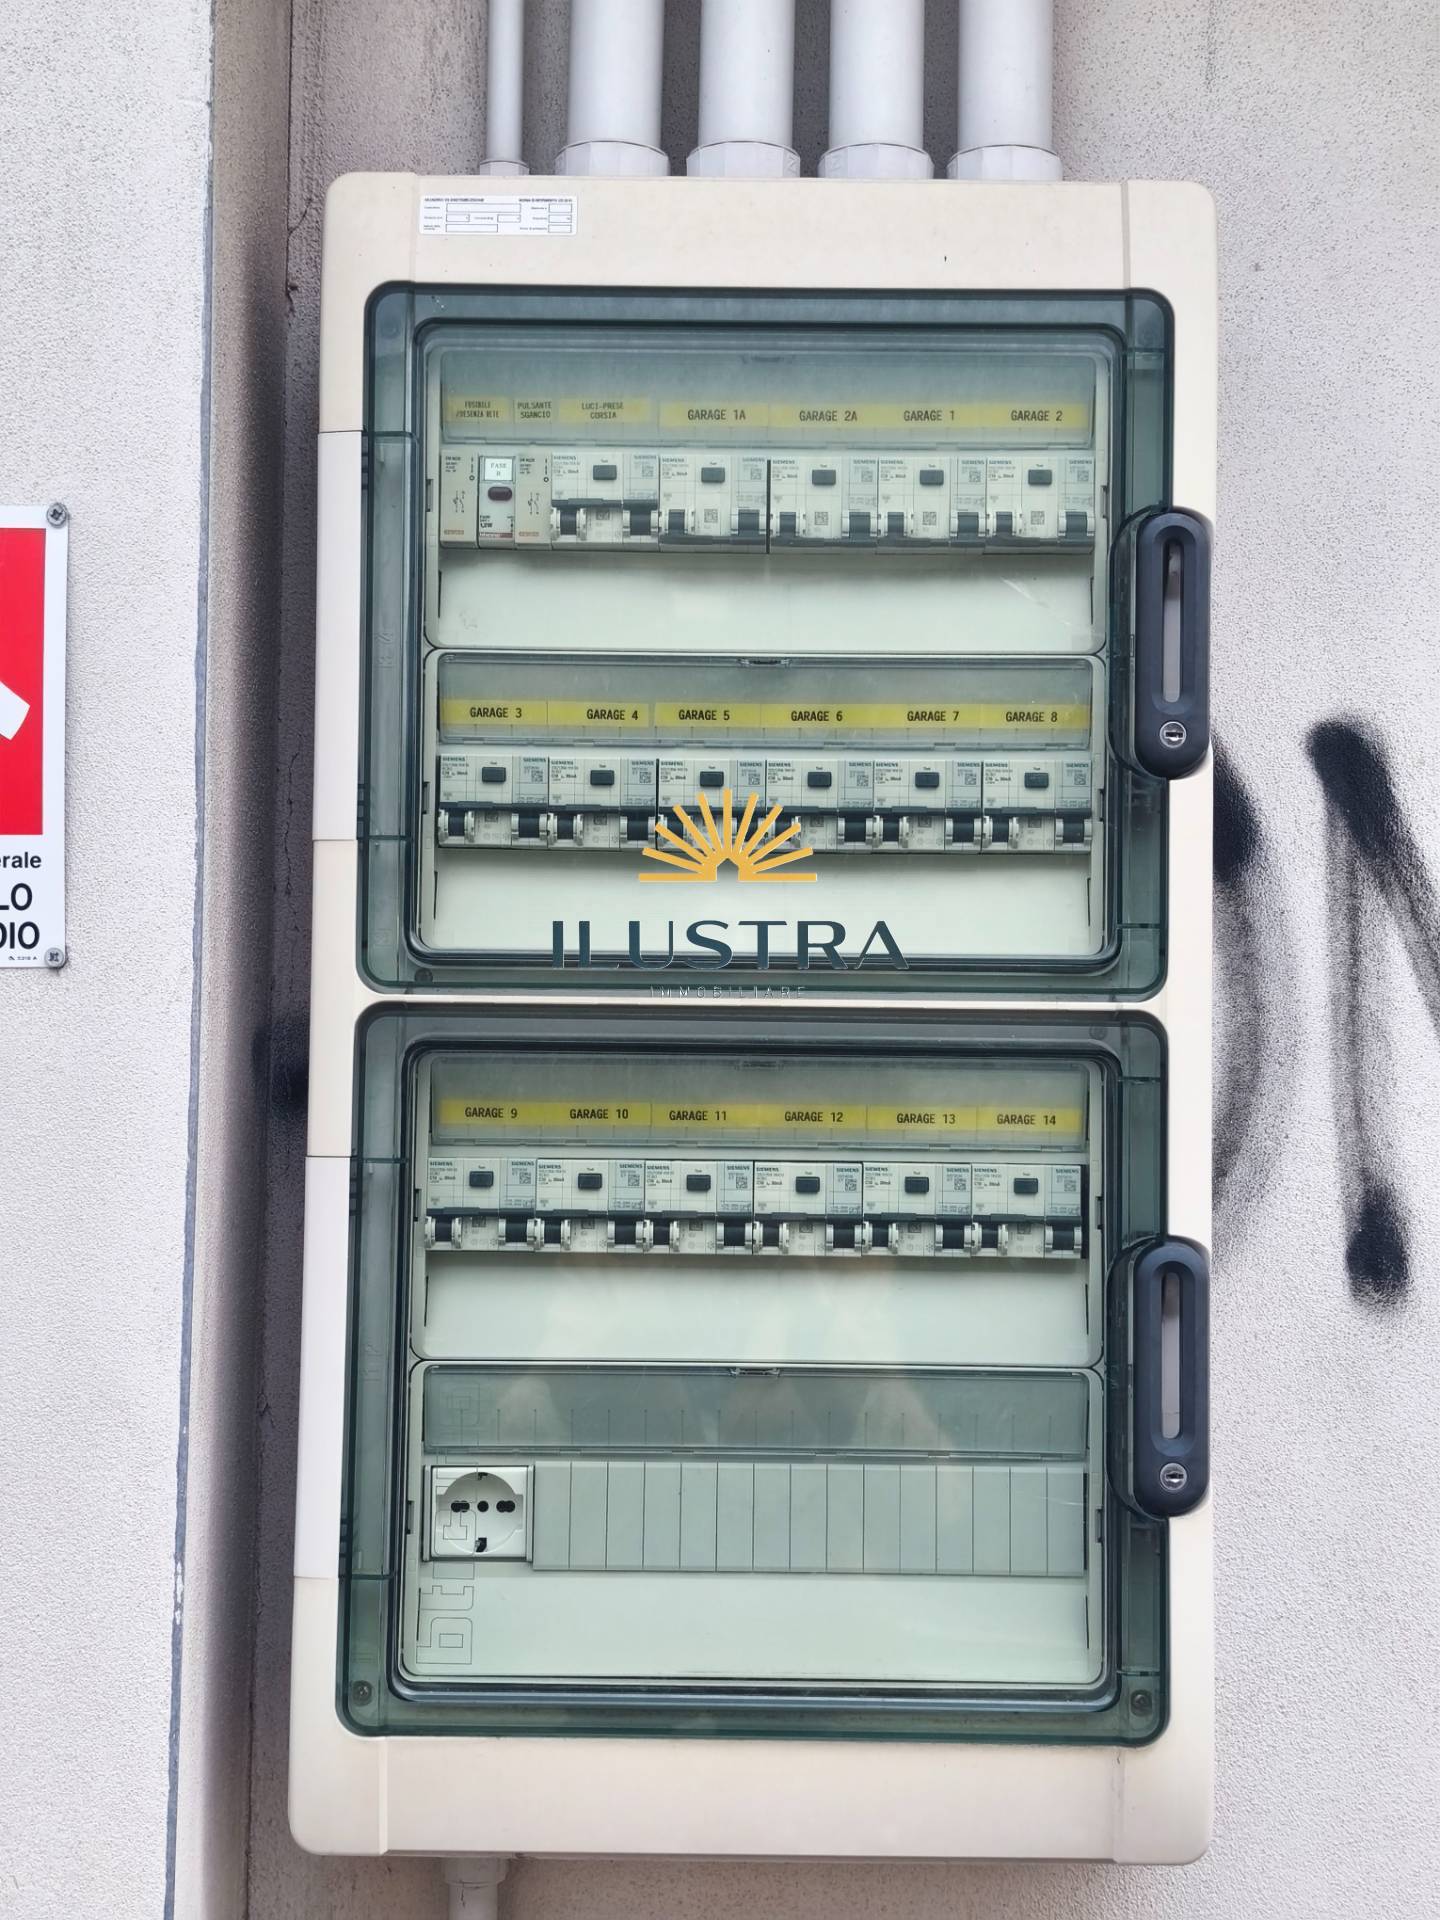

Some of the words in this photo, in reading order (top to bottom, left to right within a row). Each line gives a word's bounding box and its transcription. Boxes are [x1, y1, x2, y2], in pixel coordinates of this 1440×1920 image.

[517, 401, 552, 410] PULSANTE
[581, 401, 624, 410] LUCI-PRESE
[520, 411, 551, 419] SGANCIO
[590, 411, 617, 420] CORSIA
[687, 408, 727, 421] GARAGE
[734, 409, 747, 421] 1A
[799, 410, 838, 422] GARAGE
[844, 410, 858, 422] 2A
[903, 410, 943, 422] GARAGE
[949, 410, 955, 422] 1
[1010, 410, 1050, 422] GARAGE
[1056, 410, 1064, 422] 2
[469, 707, 509, 718] GARAGE
[515, 707, 523, 719] 3
[586, 709, 626, 721] GARAGE
[632, 709, 639, 721] 4
[678, 709, 718, 721] GARAGE
[723, 709, 731, 721] 5
[791, 710, 830, 722] GARAGE
[836, 710, 844, 722] 6
[907, 711, 947, 722] GARAGE
[953, 711, 960, 722] 7
[1005, 711, 1045, 723] GARAGE
[1051, 711, 1058, 723] 8
[0, 851, 42, 868] rale
[464, 1107, 504, 1119] GARAGE
[510, 1107, 519, 1119] 9
[569, 1109, 609, 1120] GARAGE
[615, 1109, 629, 1120] 10
[669, 1110, 708, 1121] GARAGE
[715, 1110, 728, 1121] 11
[784, 1111, 824, 1122] GARAGE
[831, 1111, 844, 1123] 12
[896, 1113, 936, 1124] GARAGE
[943, 1113, 956, 1125] 13
[996, 1114, 1036, 1125] GARAGE
[1043, 1115, 1057, 1126] 14
